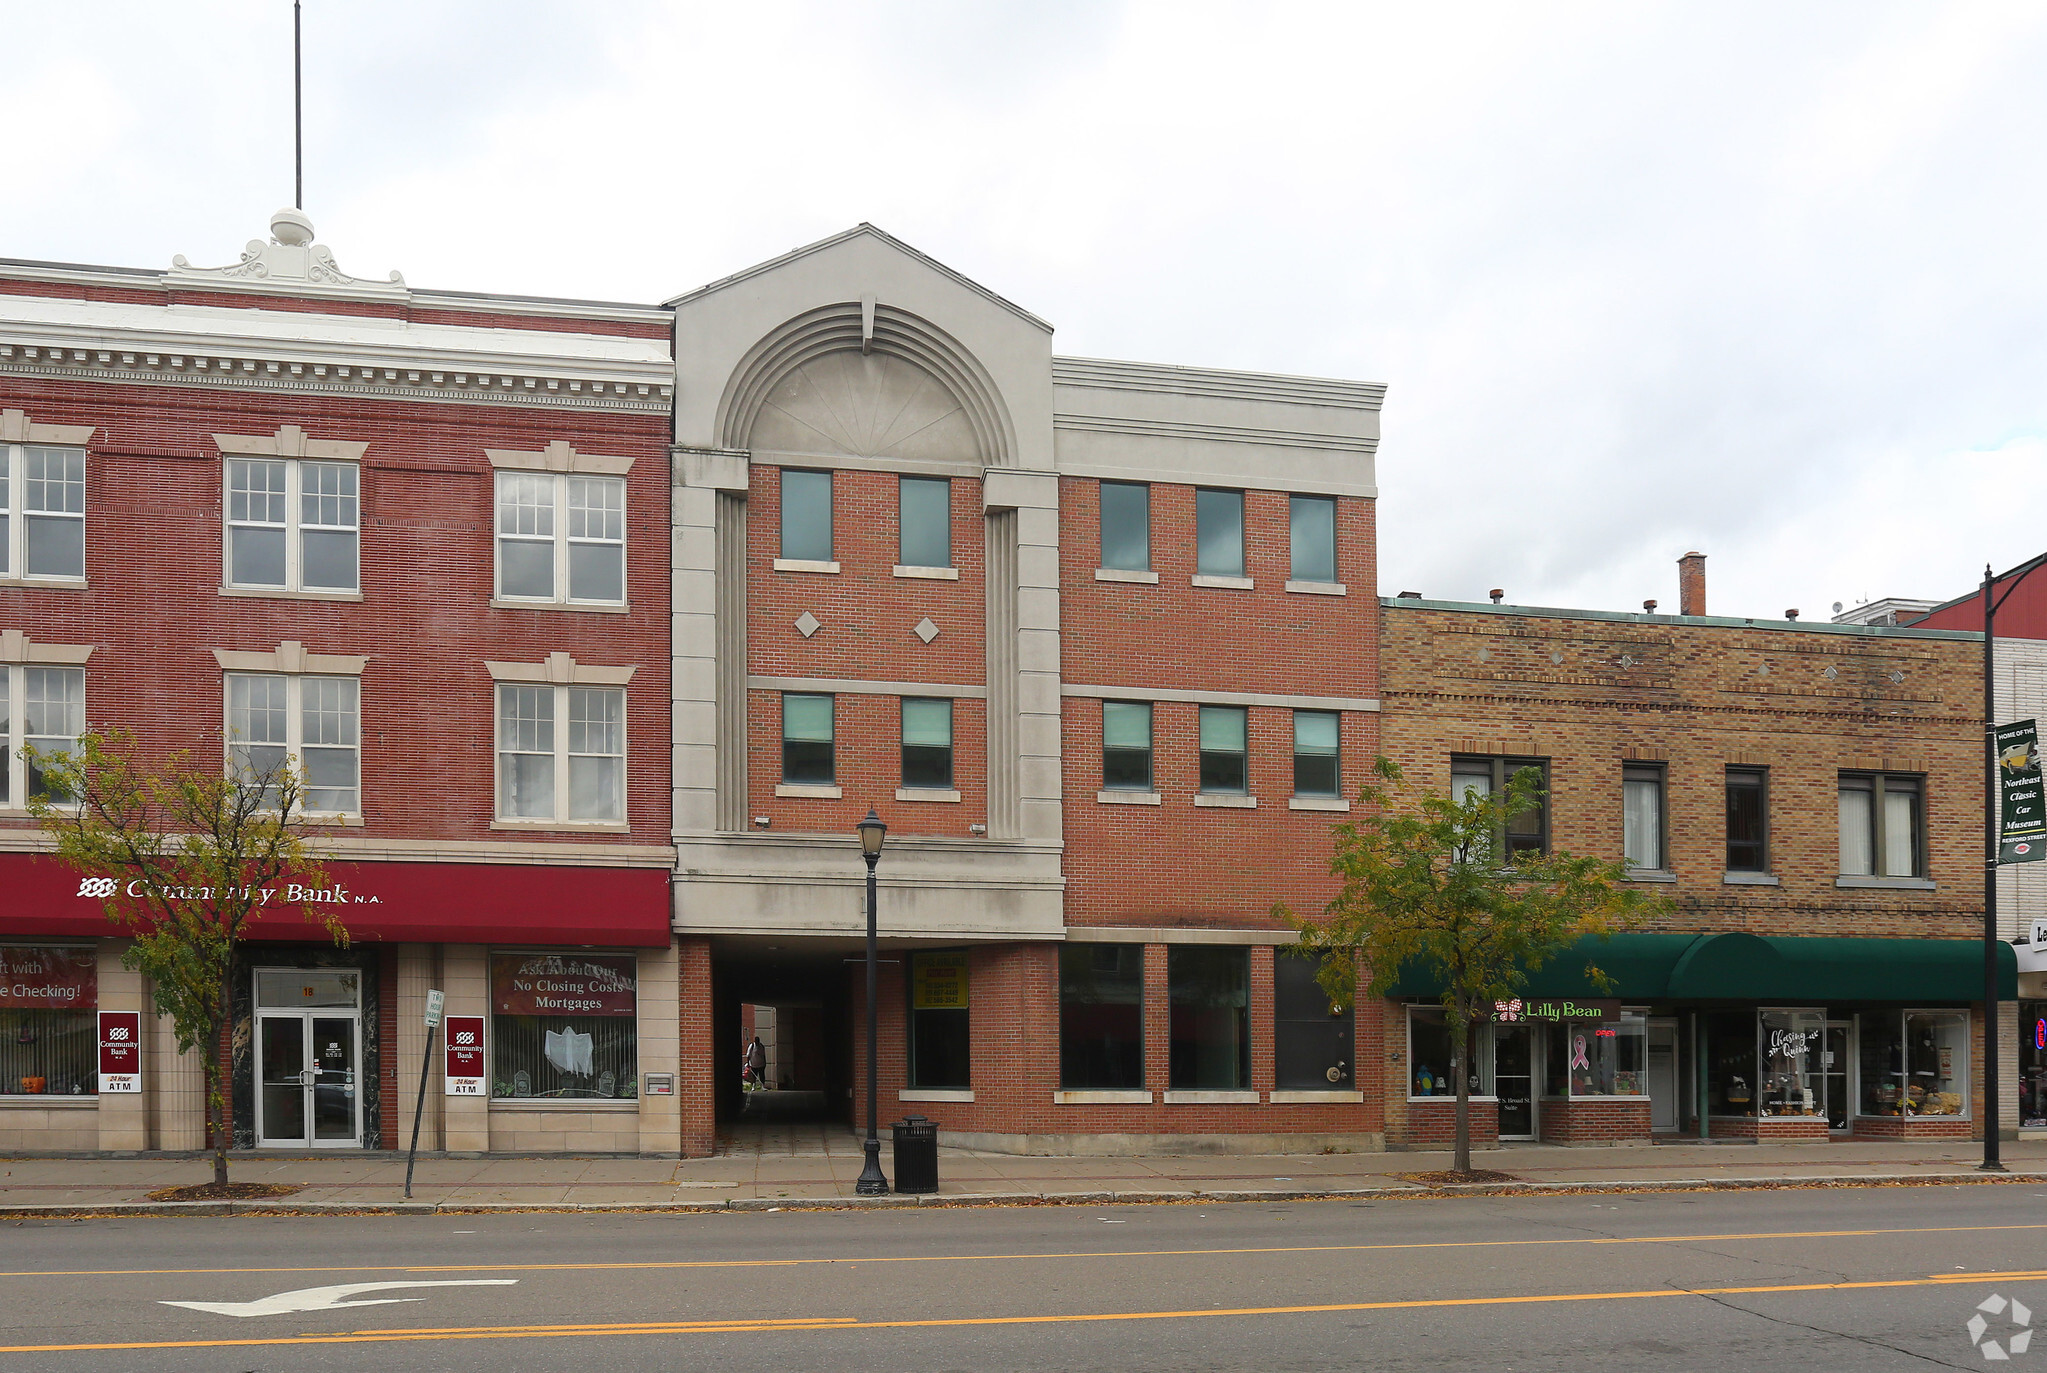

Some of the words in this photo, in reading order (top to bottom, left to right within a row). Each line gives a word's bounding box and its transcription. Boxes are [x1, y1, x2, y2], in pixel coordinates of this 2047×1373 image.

[1998, 731, 2016, 740] HOME
[2016, 729, 2023, 737] OF
[2023, 727, 2035, 735] THE
[2004, 776, 2041, 789] Northeast
[2009, 790, 2037, 802] Classic
[2016, 806, 2032, 815] Car
[2005, 820, 2042, 830] Museum
[2002, 836, 2027, 844] REXFORD
[2027, 833, 2047, 841] STREET
[126, 879, 277, 906] Cmmniy
[287, 883, 349, 904] Bank
[354, 895, 384, 904] N.A.
[12, 961, 42, 974] with
[518, 963, 544, 975] Ask
[547, 963, 590, 976] About
[12, 984, 81, 1000] Checking!
[303, 987, 314, 997] 18
[513, 979, 532, 991] No
[536, 979, 584, 995] Closing
[588, 980, 624, 993] Costs
[535, 996, 602, 1011] Mortgages
[1526, 1001, 1561, 1022] Lilly
[1563, 1001, 1602, 1017] Bean
[1595, 1029, 1616, 1037] OPEN
[1771, 1029, 1806, 1047] Chasing
[100, 1040, 138, 1049] Community
[447, 1045, 483, 1053] Community
[1783, 1043, 1811, 1059] Quinn
